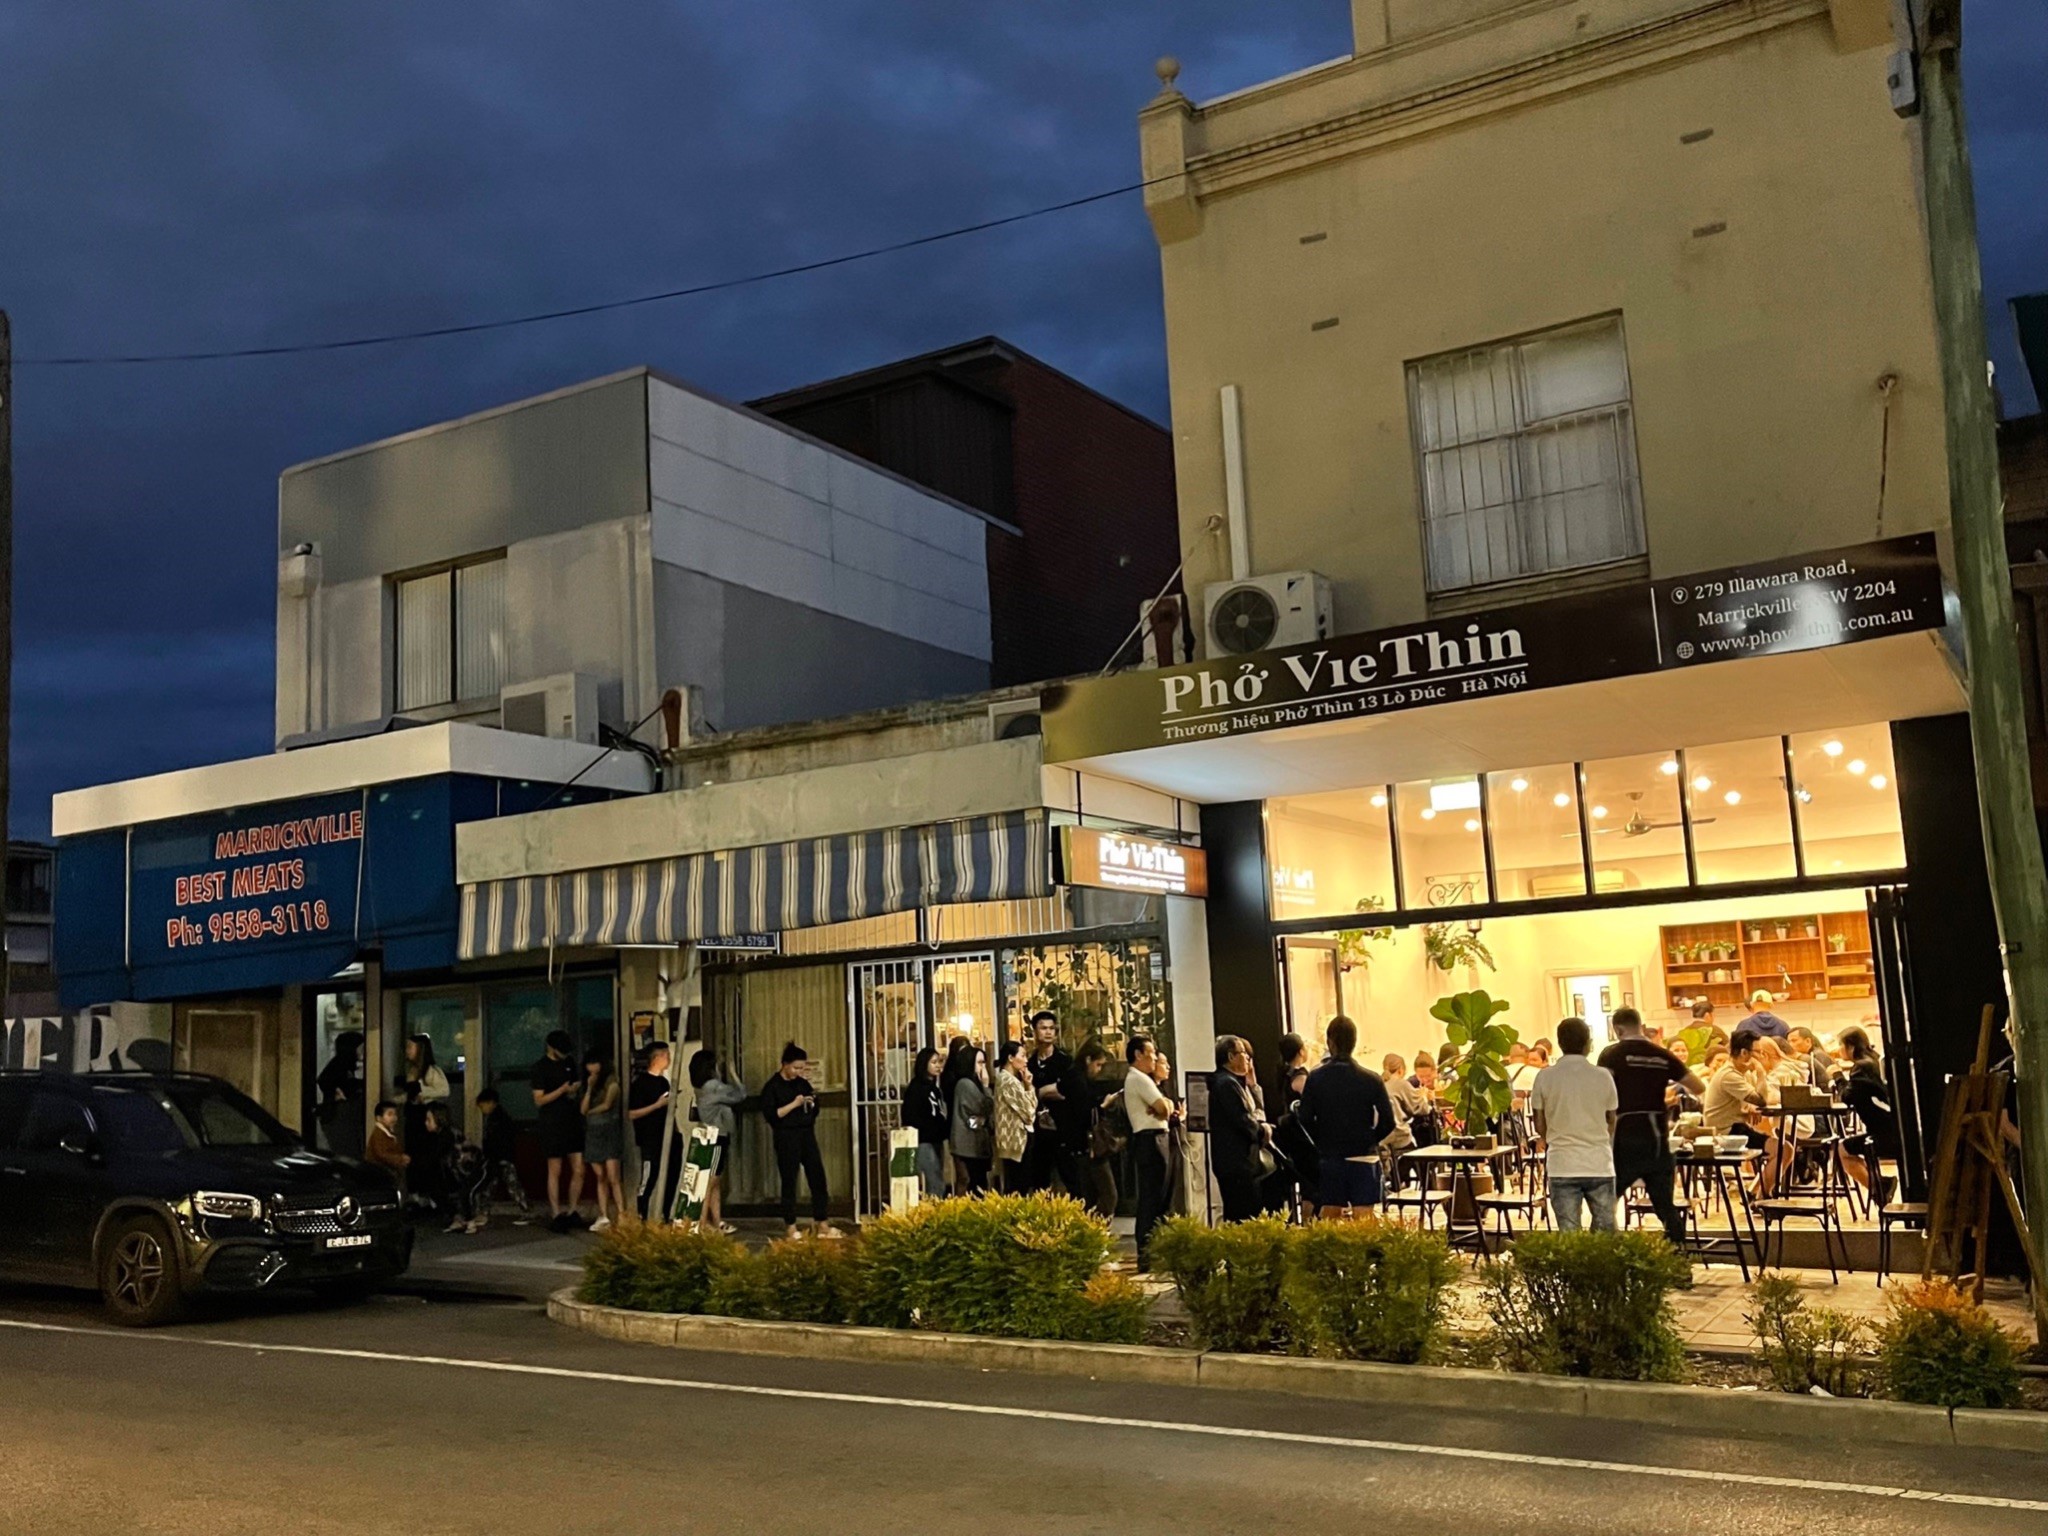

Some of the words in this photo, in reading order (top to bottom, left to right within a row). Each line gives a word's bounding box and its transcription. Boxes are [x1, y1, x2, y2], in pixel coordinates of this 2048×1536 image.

[1695, 582, 1724, 600] 279
[1728, 571, 1799, 594] Illawara
[1804, 559, 1856, 581] Road,
[1854, 580, 1897, 601] 2204
[1159, 663, 1269, 714] Phở
[1163, 721, 1229, 739] Thương
[1233, 713, 1270, 729] hiệu
[1274, 706, 1309, 723] Phở
[1312, 700, 1354, 717] Thìn
[1358, 695, 1378, 709] 13
[1383, 691, 1406, 706] Lò
[1410, 685, 1446, 701] Đúc
[1462, 678, 1489, 693] Hà
[1493, 671, 1528, 689] Nội
[215, 810, 364, 859] MARRICKVILLE
[176, 871, 226, 906] BEST
[232, 859, 305, 898] MEATS
[167, 916, 203, 948] Ph:
[208, 899, 330, 943] 9558-3118
